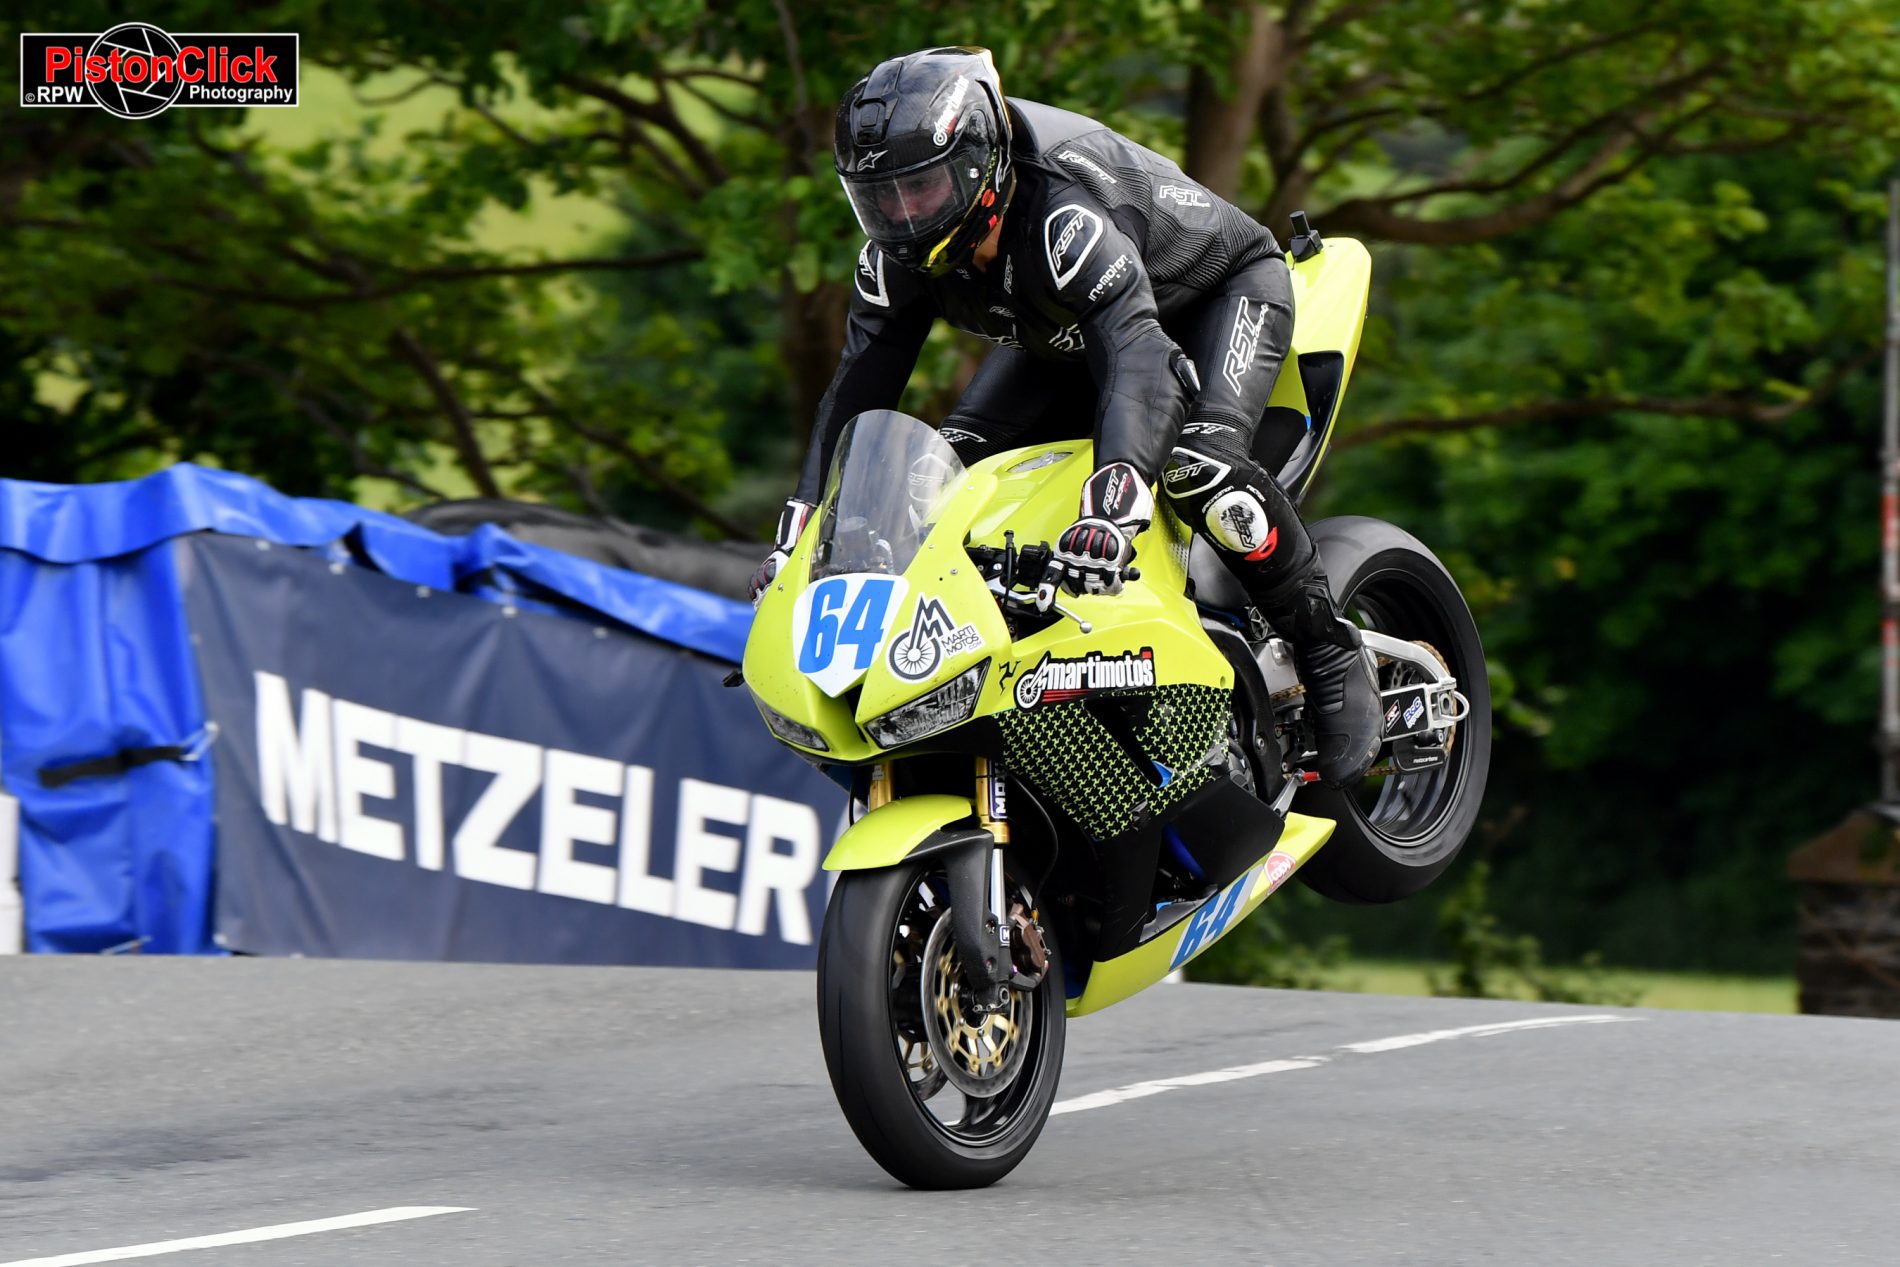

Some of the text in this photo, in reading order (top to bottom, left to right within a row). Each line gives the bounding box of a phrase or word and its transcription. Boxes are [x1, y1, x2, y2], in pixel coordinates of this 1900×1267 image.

[1159, 184, 1202, 202] RST
[1052, 211, 1085, 271] RST
[1223, 296, 1255, 397] RST
[1103, 468, 1119, 516] RST
[1164, 461, 1210, 485] RST
[798, 578, 895, 674] 64
[941, 625, 975, 648] MARTI
[946, 633, 979, 656] MOTOS
[1050, 655, 1154, 690] martimotos
[255, 671, 821, 946] METZELER
[1169, 871, 1250, 972] 64
